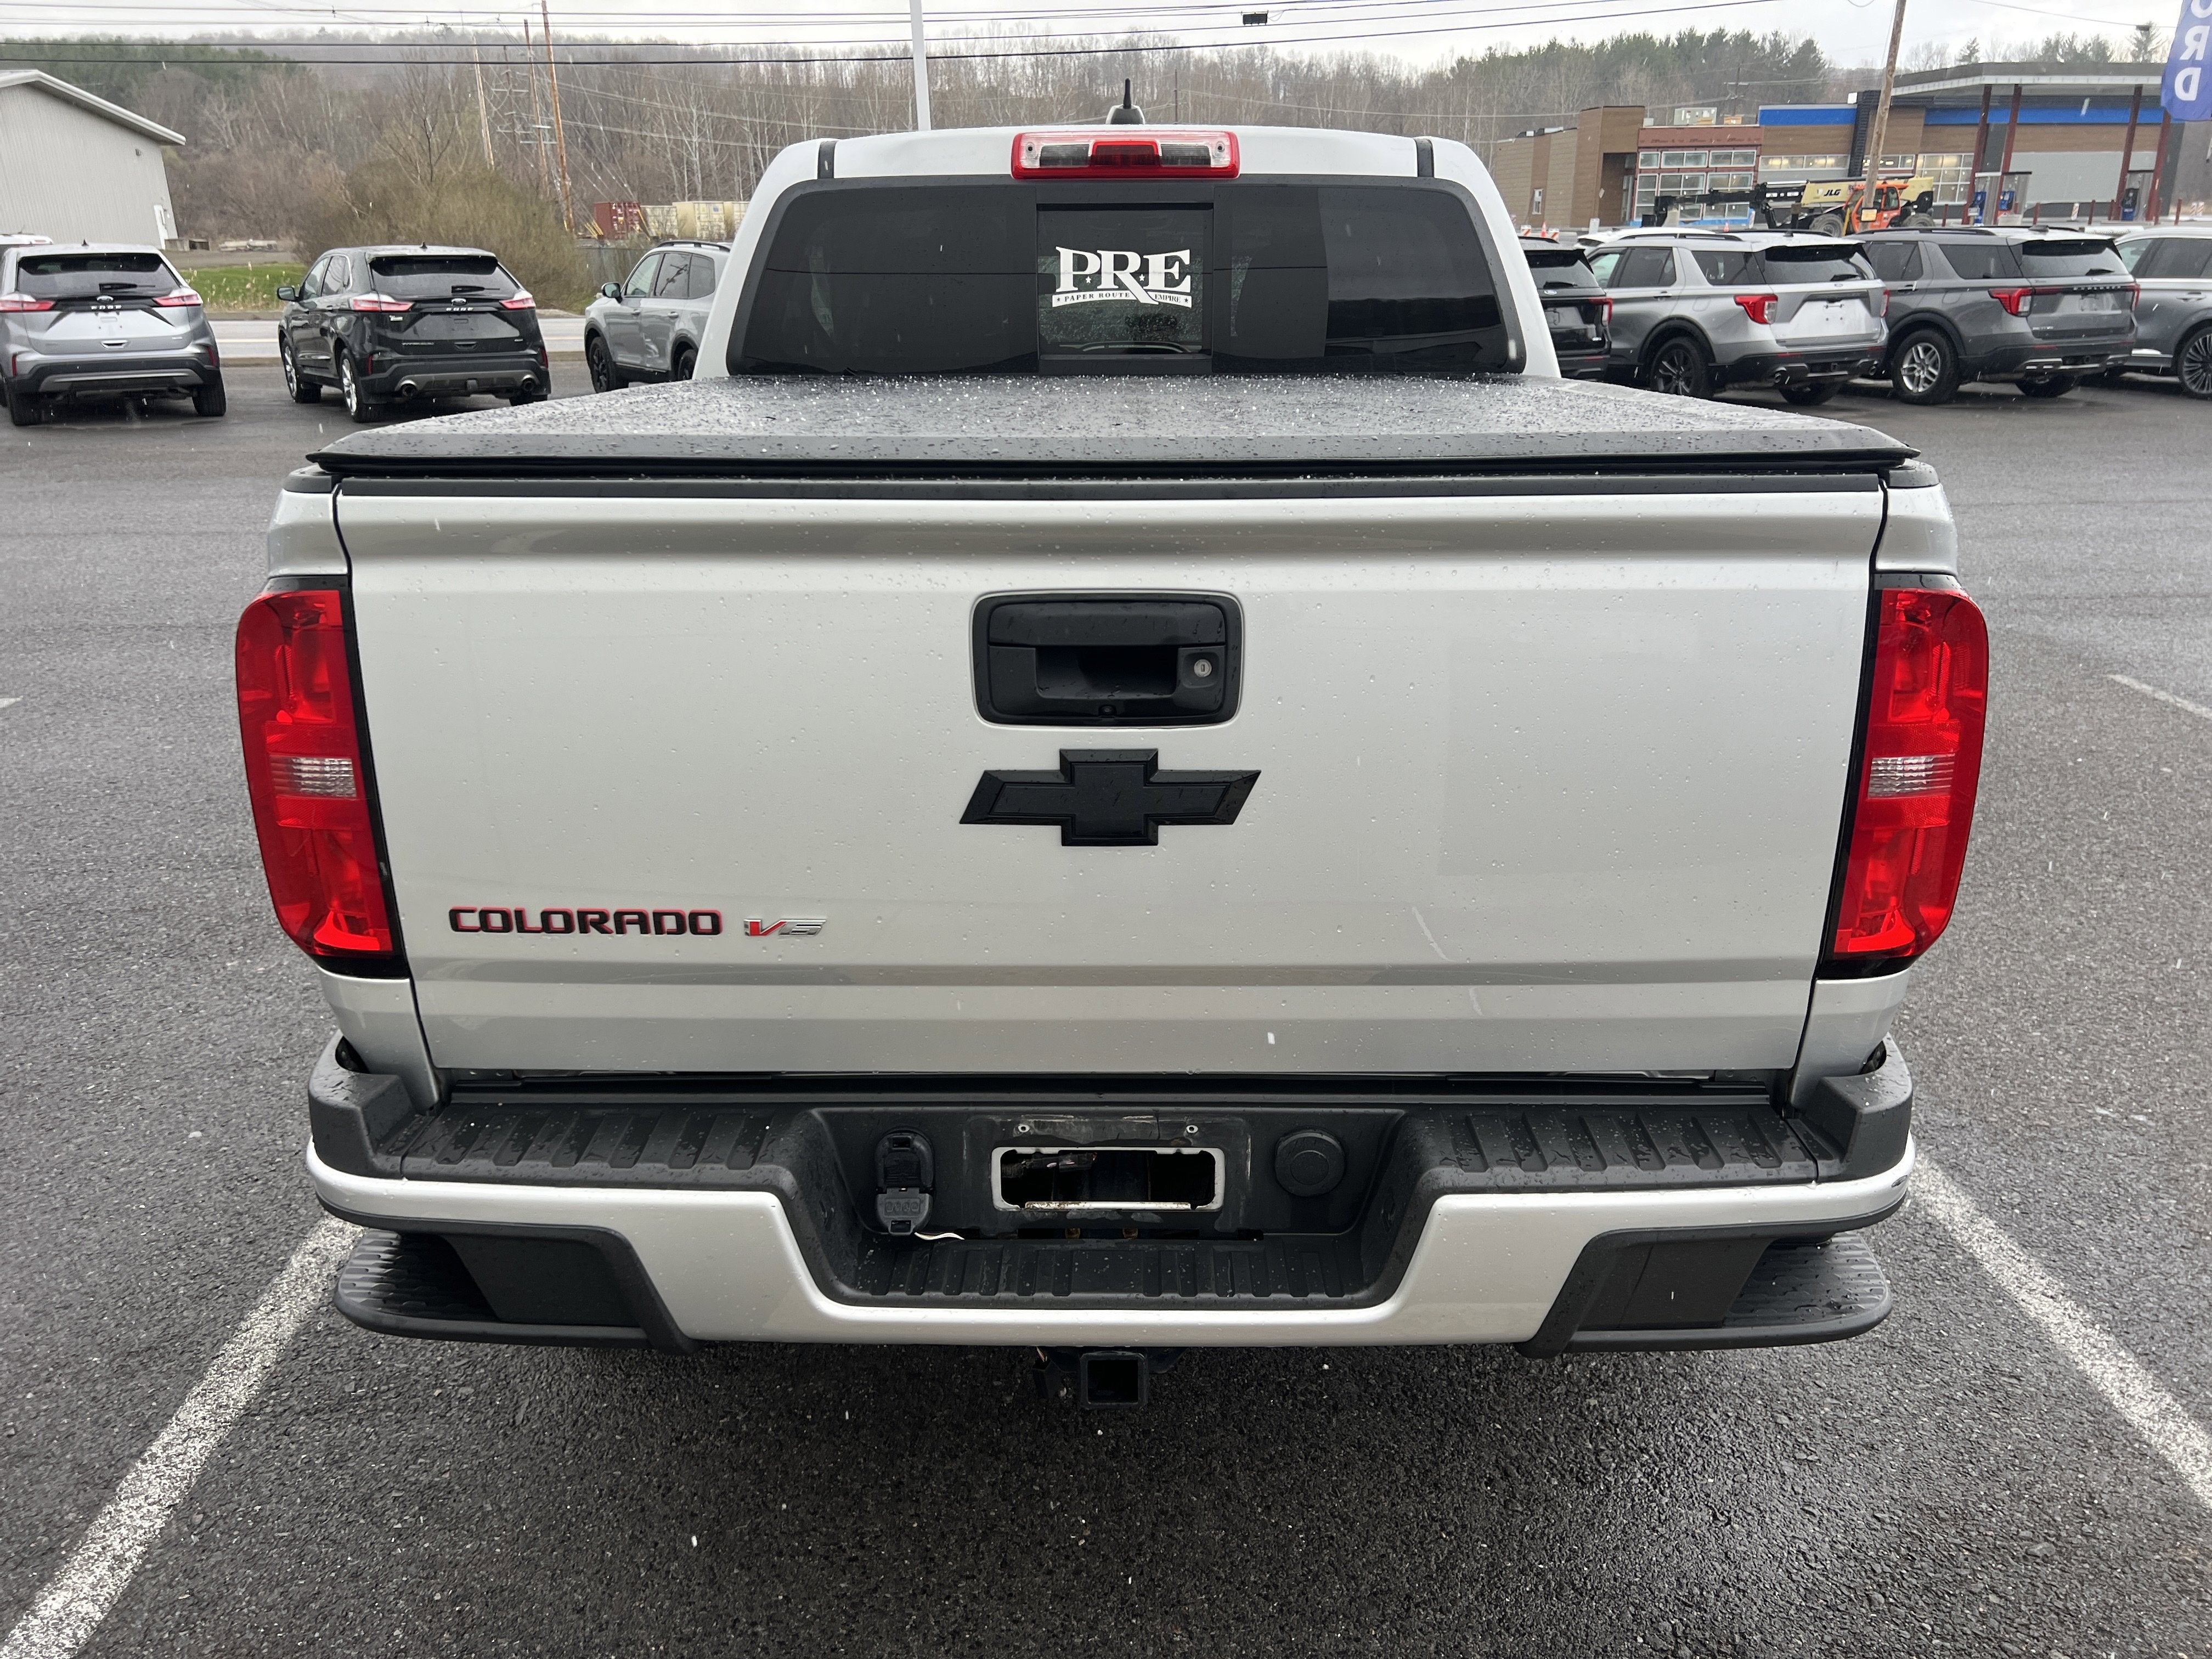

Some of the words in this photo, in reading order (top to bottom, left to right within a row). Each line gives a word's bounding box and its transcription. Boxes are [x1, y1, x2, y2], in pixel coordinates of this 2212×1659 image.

[1056, 246, 1191, 305] PRE
[1064, 294, 1094, 302] PAPER
[1154, 294, 1181, 303] EMPIRE
[449, 906, 723, 936] COLORADO
[743, 918, 827, 936] V6
